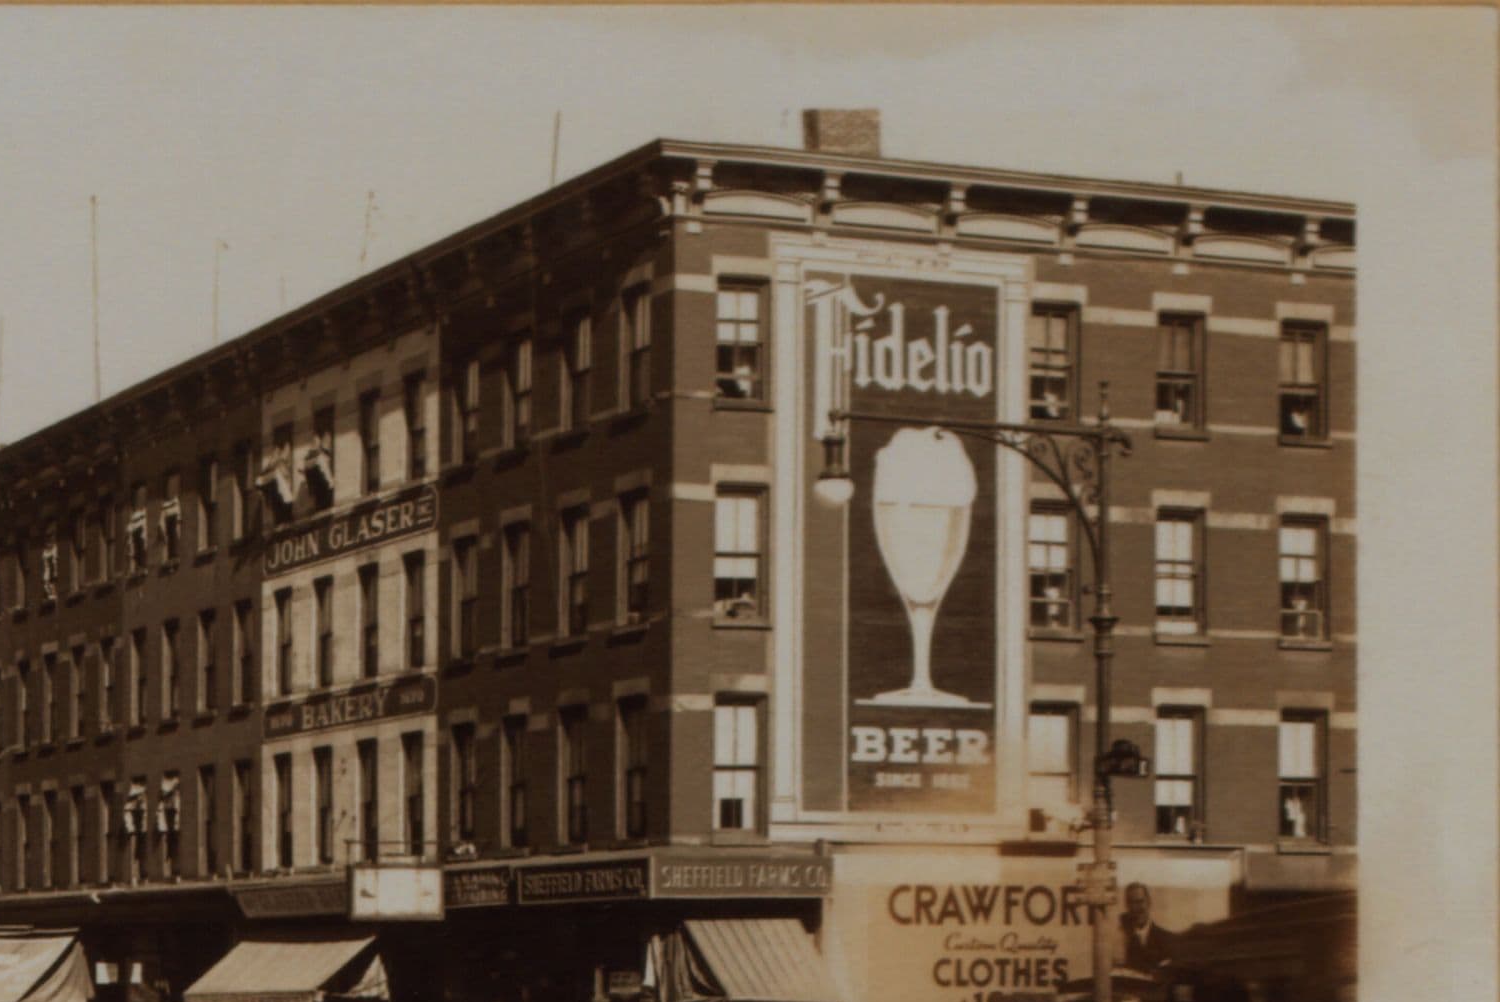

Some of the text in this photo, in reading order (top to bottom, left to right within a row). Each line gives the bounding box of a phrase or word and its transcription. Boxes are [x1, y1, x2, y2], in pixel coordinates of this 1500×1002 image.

[803, 279, 992, 438] Fidelio
[268, 530, 319, 569] JOHN
[329, 501, 414, 549] GLASER
[301, 688, 389, 731] BAKERY
[851, 726, 992, 765] BEER
[524, 872, 582, 896] SHEFFIELD
[661, 864, 743, 889] SHEFFIELD
[748, 864, 800, 889] FARMS
[944, 932, 1059, 954] Custom Quality
[933, 958, 1068, 987] CLOTHES
